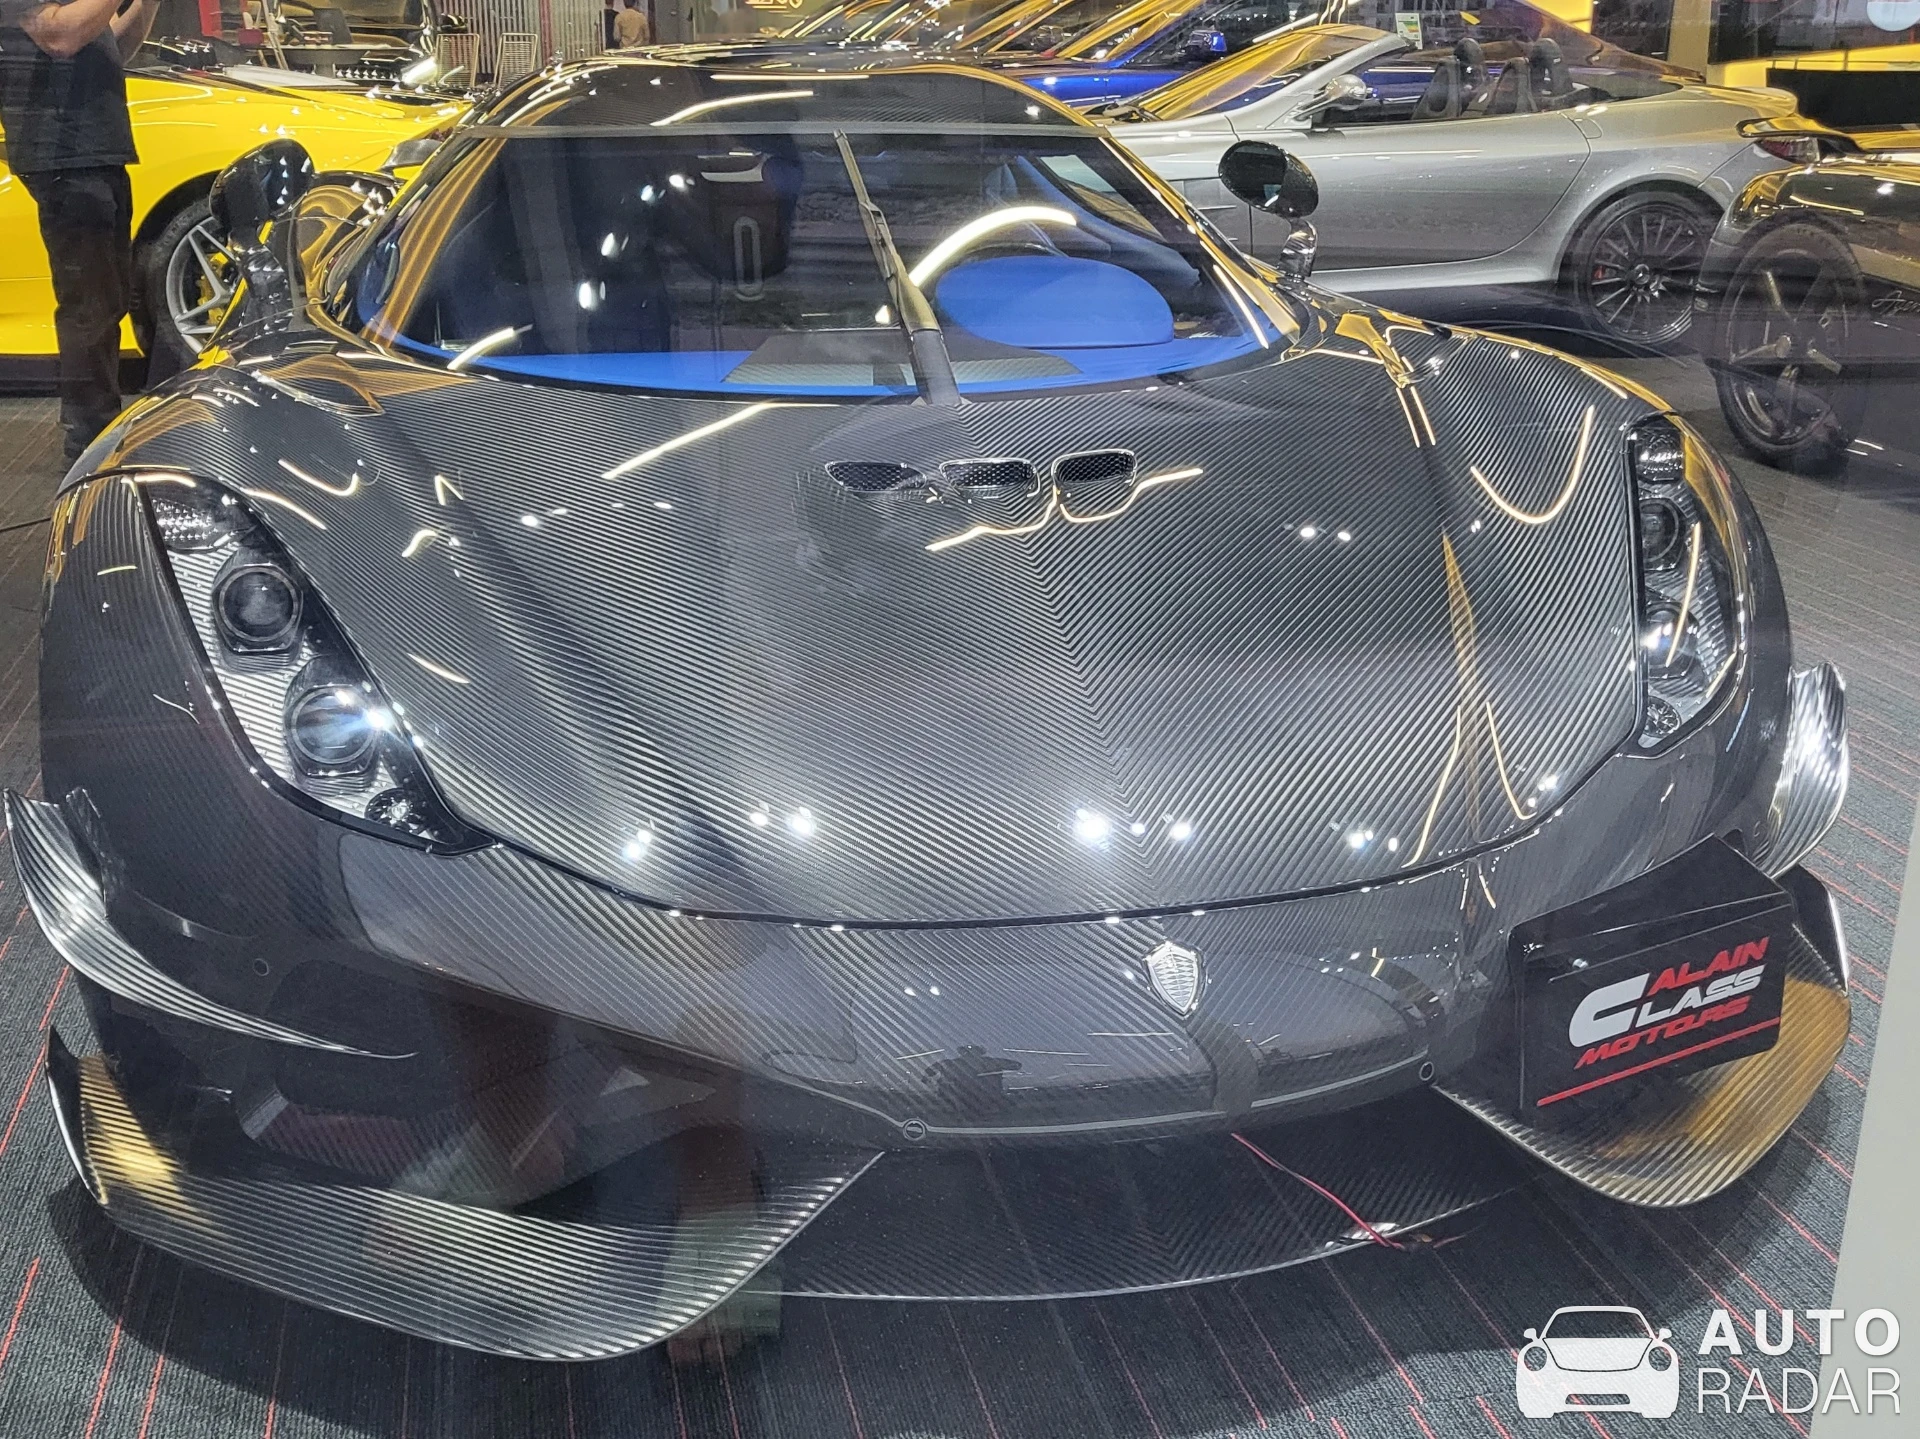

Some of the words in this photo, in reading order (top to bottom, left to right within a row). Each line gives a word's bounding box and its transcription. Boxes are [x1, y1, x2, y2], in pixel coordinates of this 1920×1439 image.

[1648, 937, 1769, 995] ALAIN
[1569, 965, 1765, 1047] CLASS
[1575, 996, 1750, 1069] MOTORS
